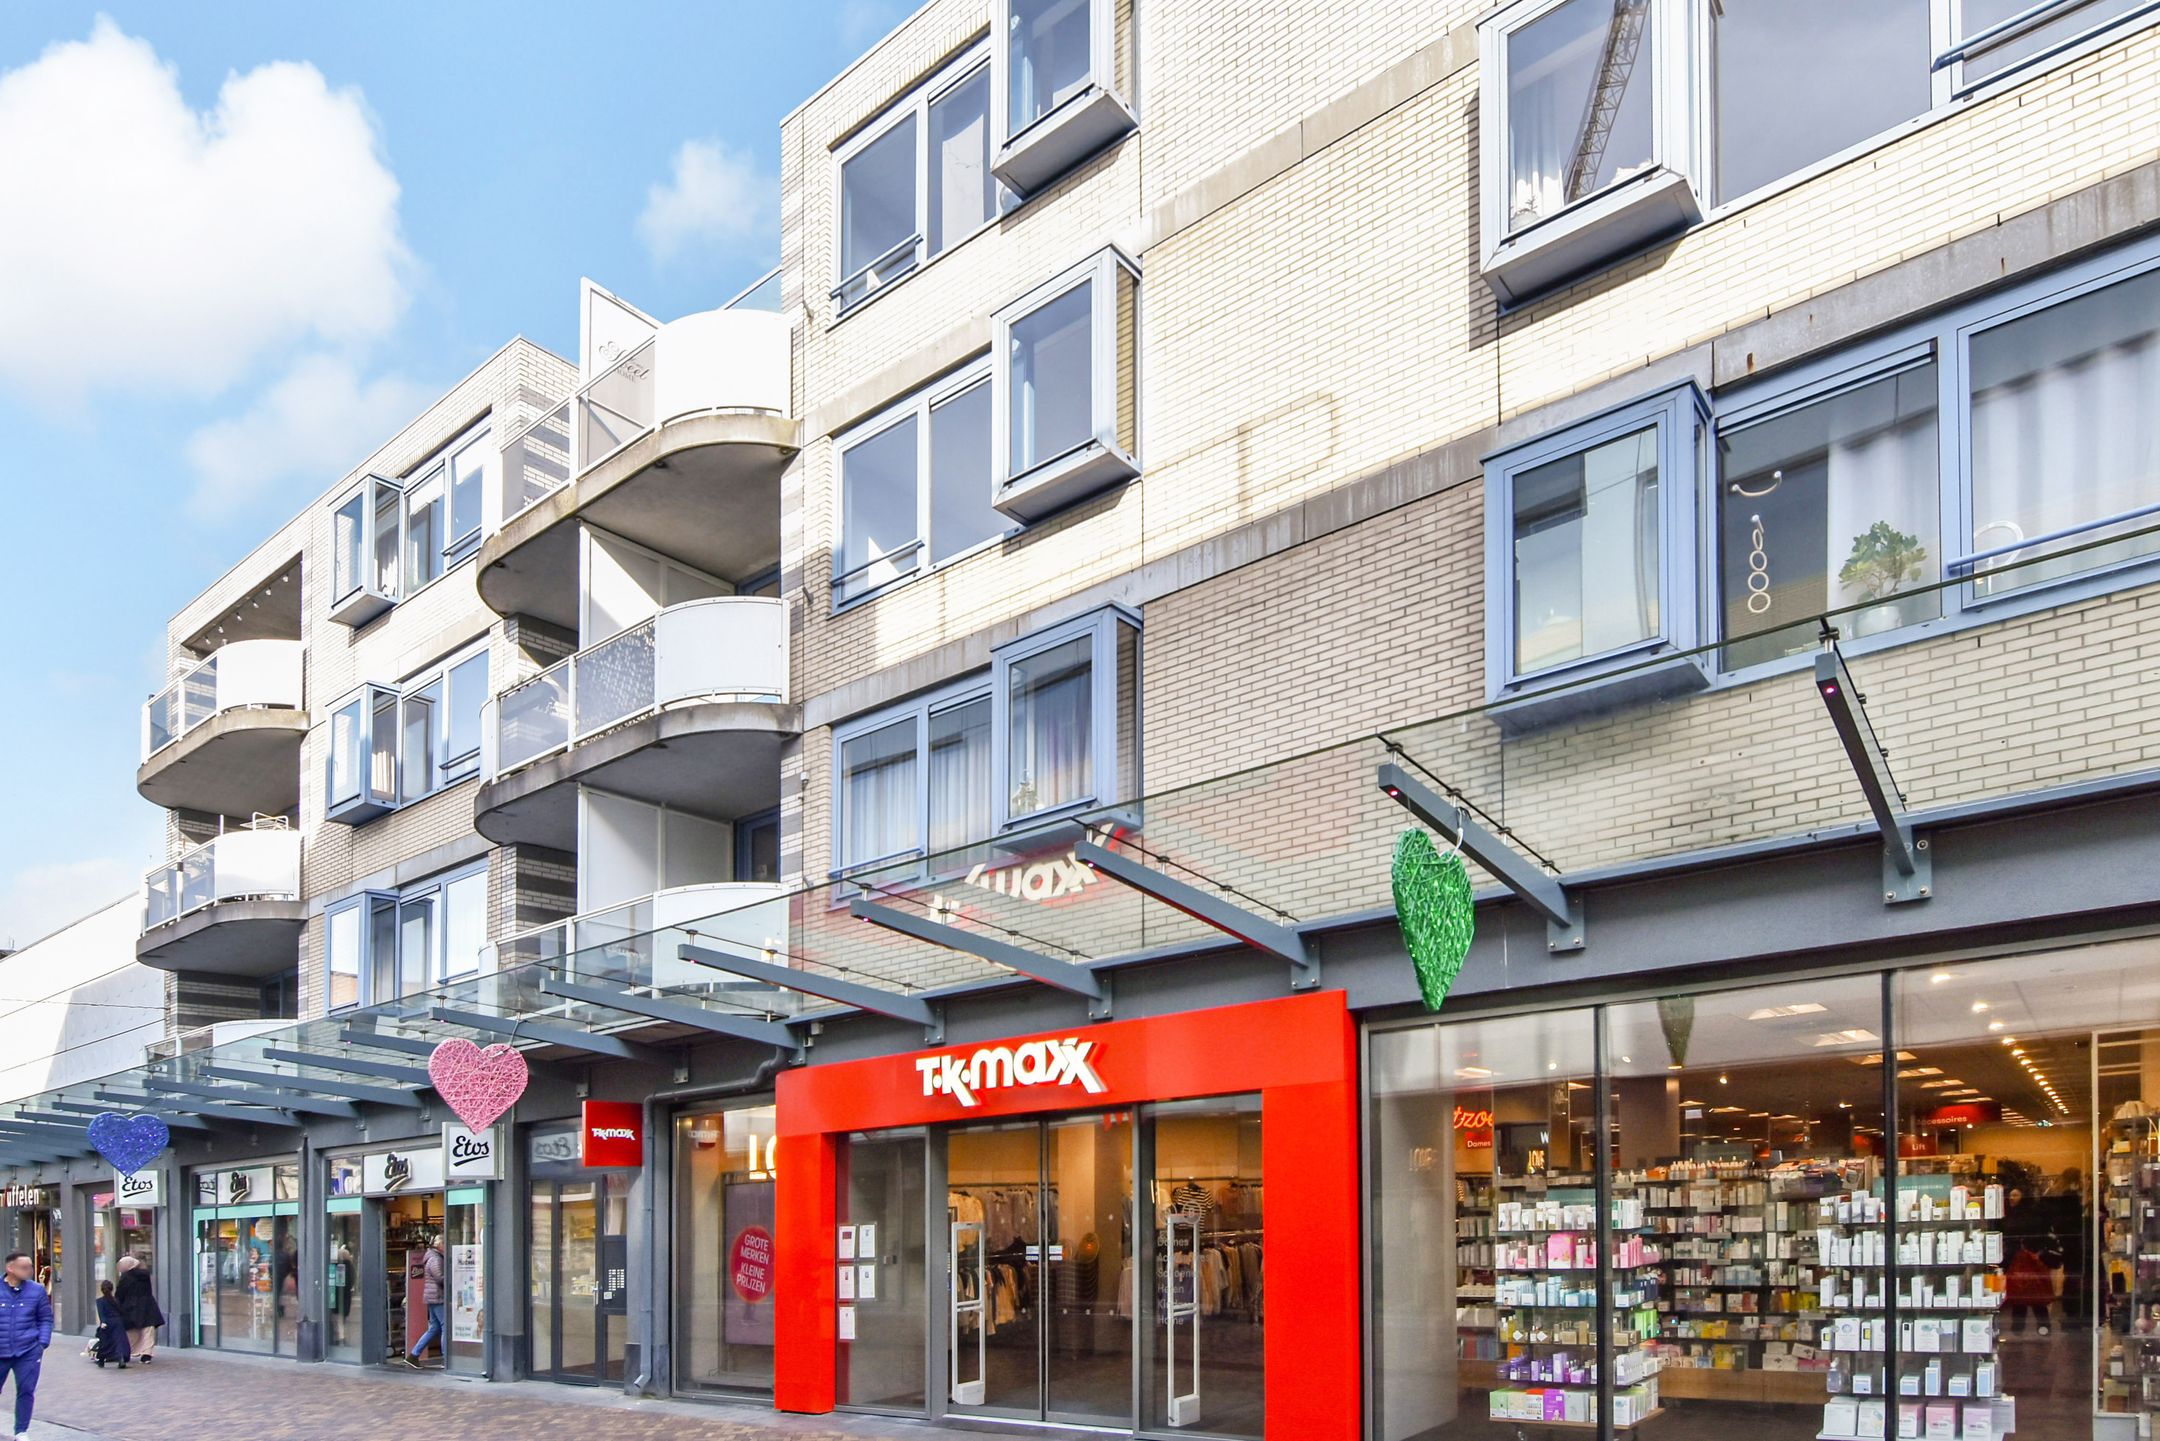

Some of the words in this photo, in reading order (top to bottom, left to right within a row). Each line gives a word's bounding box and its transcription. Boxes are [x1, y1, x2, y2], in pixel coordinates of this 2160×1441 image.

[452, 1135, 490, 1163] Etos
[121, 1176, 154, 1195] Etos
[744, 1234, 769, 1251] GROTE
[741, 1245, 770, 1265] MERKEN
[740, 1262, 765, 1280] KLEINE
[736, 1273, 766, 1294] PRIJZEN
